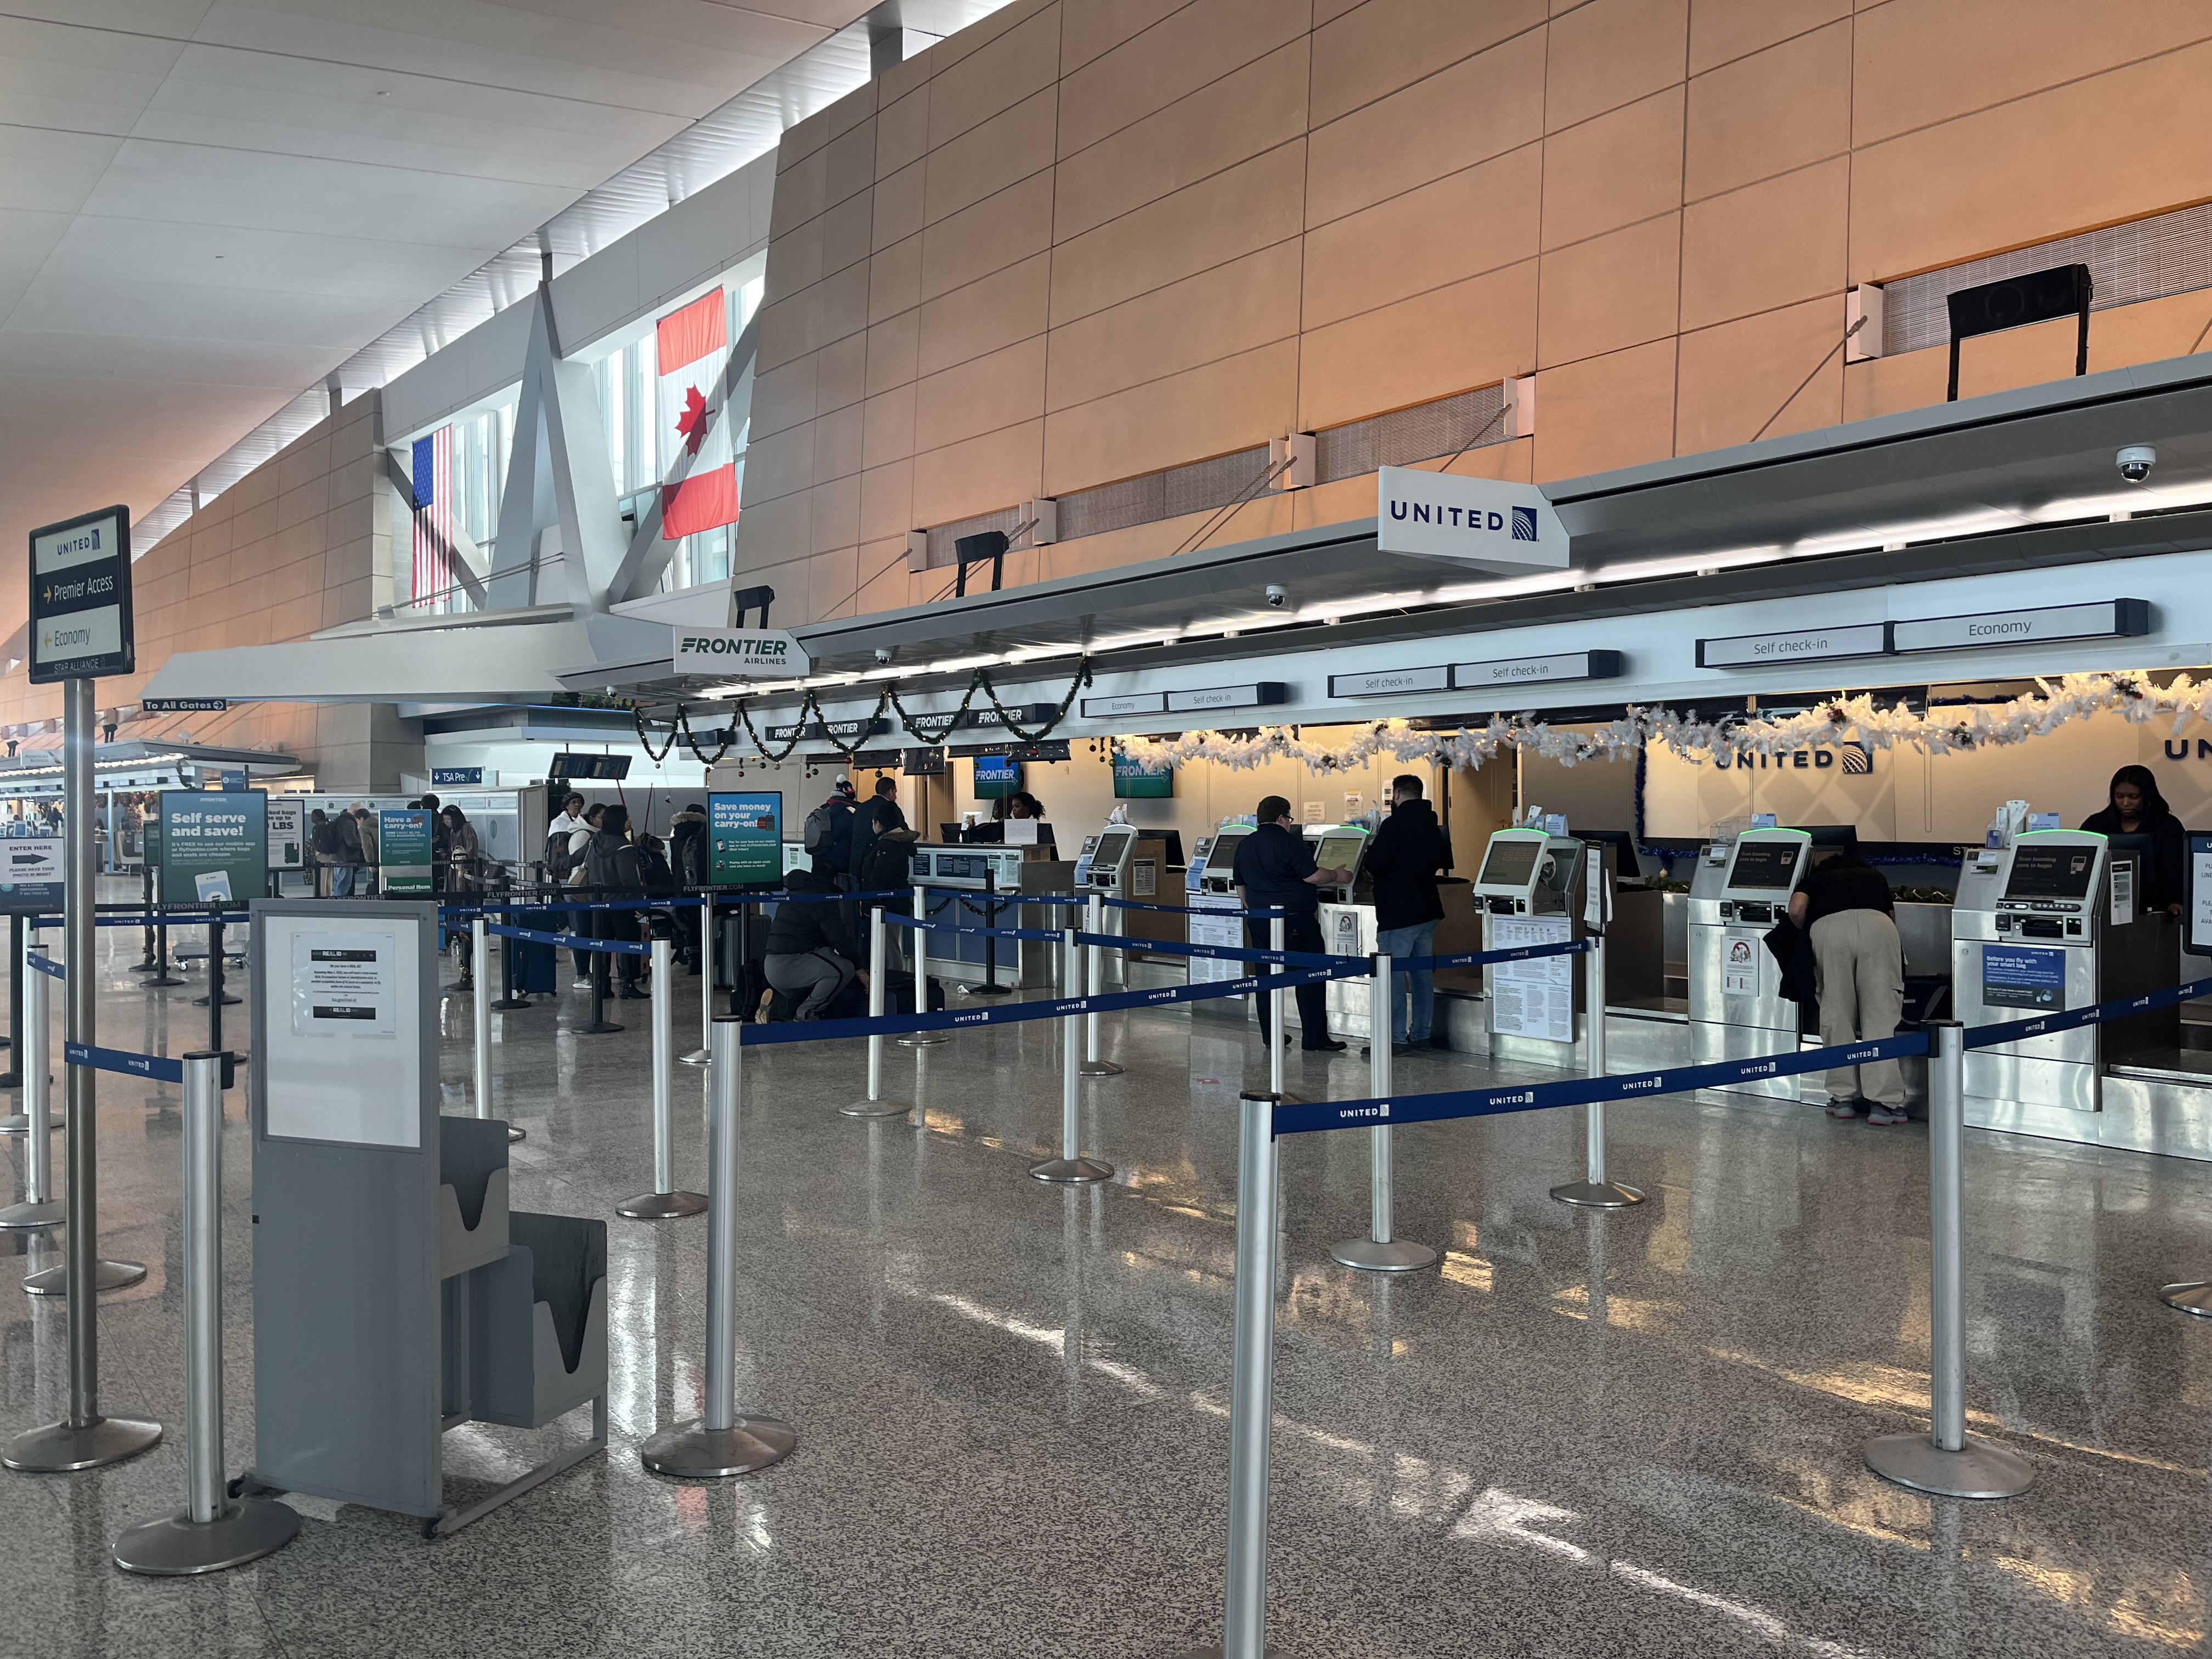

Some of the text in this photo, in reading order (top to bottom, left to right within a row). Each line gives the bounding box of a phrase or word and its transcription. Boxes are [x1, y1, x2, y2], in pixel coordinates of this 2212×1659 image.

[1391, 500, 1504, 531] UNITED
[57, 536, 90, 556] UNITED
[54, 575, 114, 601] Premier Access
[1968, 619, 2032, 637] Economy
[55, 627, 91, 647] Economy
[680, 637, 787, 656] FRONTIER
[1753, 638, 1828, 656] Self check-in
[54, 658, 99, 673] STAR ALLIANCE
[1492, 664, 1549, 678] Self check-in
[1365, 676, 1413, 689] Self check-in
[1193, 693, 1232, 704] Self check-in
[146, 701, 159, 709] To
[179, 701, 211, 709] Gates
[1111, 702, 1135, 710] Economy
[827, 723, 859, 735] RONTIER
[442, 772, 465, 782] TSA Pre
[975, 769, 1014, 780] FRONTIER
[714, 803, 737, 811] Save
[171, 812, 247, 823] Self serve
[714, 820, 758, 828] carry-on!
[171, 826, 201, 837] and
[204, 826, 244, 836] save!
[487, 889, 557, 898] FLYFRONTIER.COM
[151, 901, 240, 911] FLYFRONTIER.COM
[1056, 1003, 1080, 1011] UNITED
[2082, 1012, 2096, 1020] UNITED
[2025, 1024, 2040, 1032] UNITED
[1847, 1051, 1871, 1059] UNITED
[128, 1060, 144, 1068] UNITED
[1741, 1065, 1768, 1074] UNITED
[1623, 1080, 1653, 1090] UNITED
[1489, 1096, 1523, 1104] UNITED
[1340, 1108, 1378, 1118] UNITED
